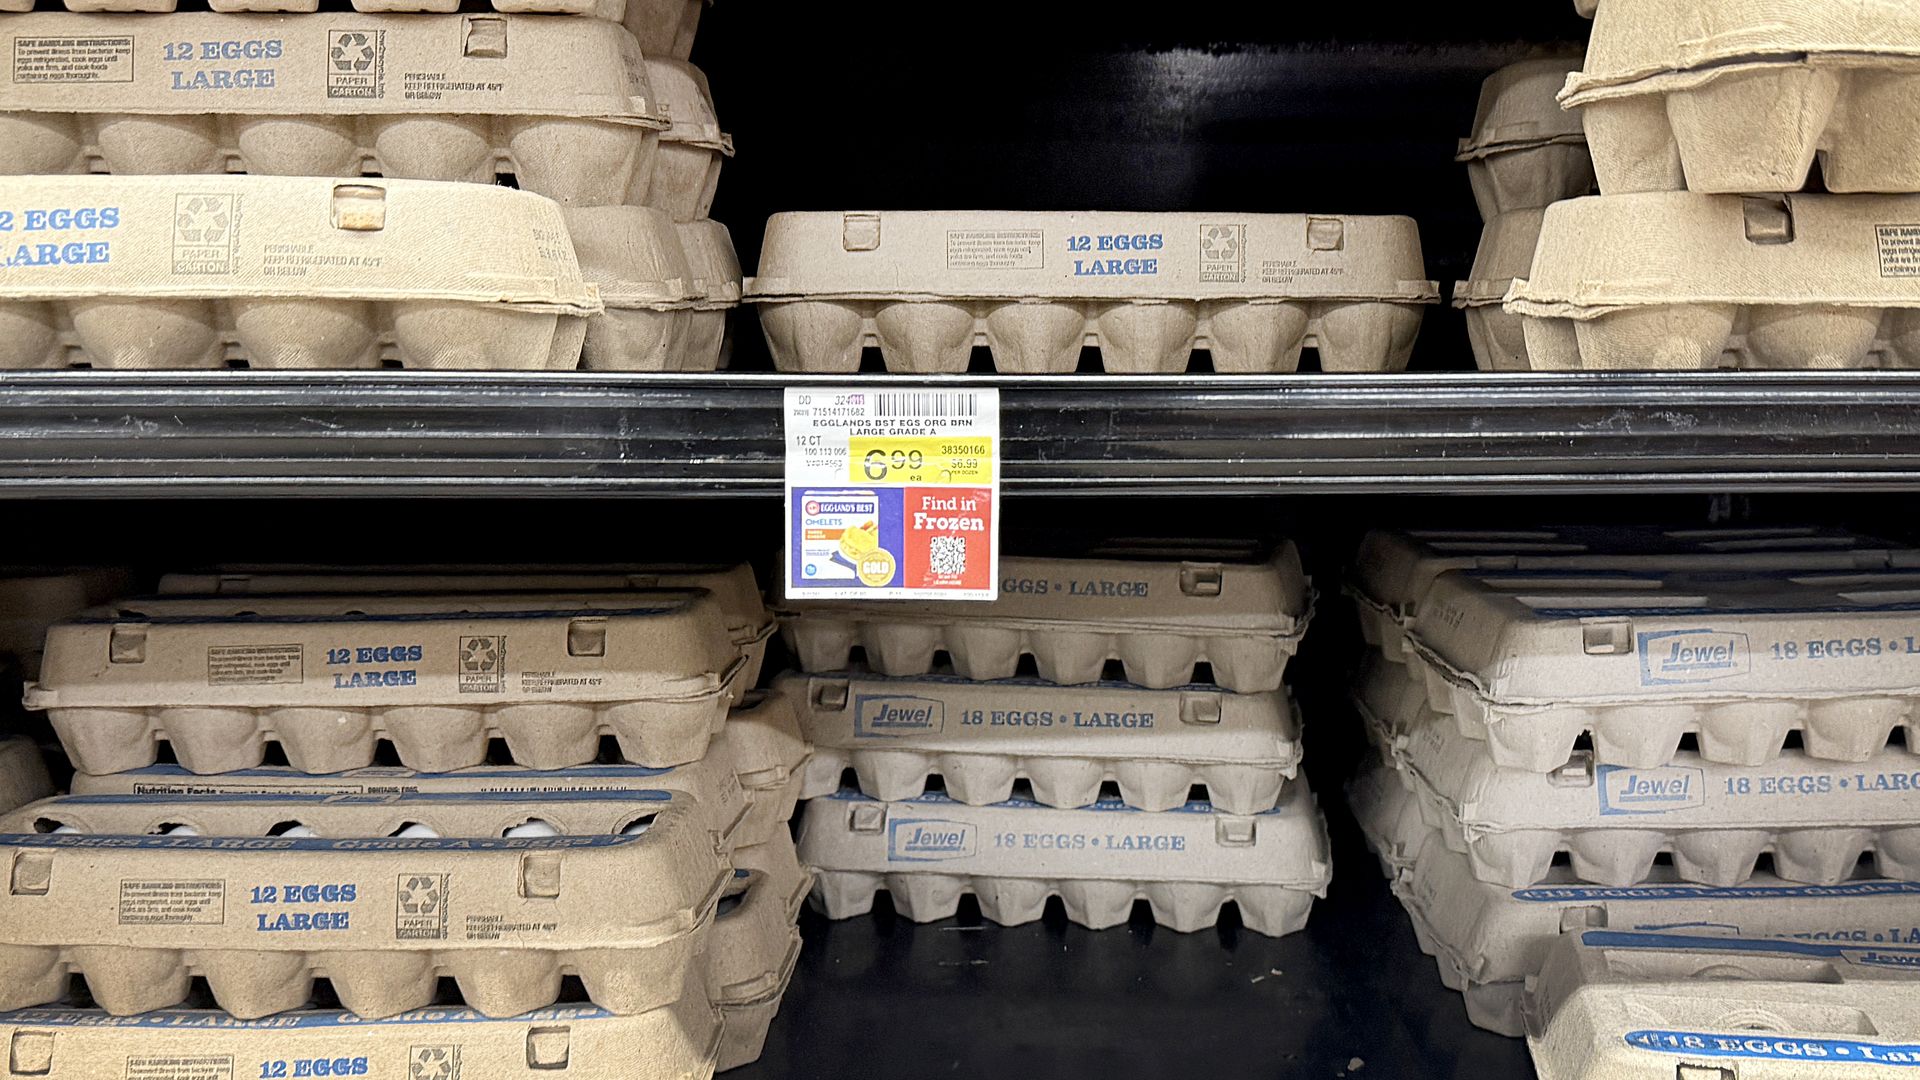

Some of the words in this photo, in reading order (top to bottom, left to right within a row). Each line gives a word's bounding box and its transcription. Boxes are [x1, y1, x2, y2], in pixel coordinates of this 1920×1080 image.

[162, 43, 194, 60] 12
[200, 40, 283, 60] EGGS
[170, 68, 275, 90] LARGE
[336, 77, 368, 85] PAPER
[476, 82, 486, 90] AT
[331, 88, 373, 96] CARTON
[23, 207, 120, 231] EGGS
[1879, 228, 1898, 236] SAFE
[1066, 236, 1092, 252] 12
[1096, 234, 1164, 251] EGGS
[182, 250, 220, 259] PAPER
[1074, 258, 1158, 276] LARGE
[798, 395, 812, 405] DD
[812, 408, 865, 416] 71514171682
[813, 419, 871, 427] EGGLANDS
[796, 436, 806, 446] 12
[809, 436, 822, 446] CT
[942, 445, 985, 454] 38350166
[922, 496, 957, 510] Find
[960, 496, 976, 511] in
[914, 512, 984, 531] Frozen
[862, 562, 890, 574] GOLD
[1001, 578, 1048, 594] GGS
[1069, 580, 1149, 597] LARGE
[326, 648, 350, 665] 12
[356, 645, 422, 664] EGGS
[1662, 640, 1735, 664] Jewel
[1771, 640, 1798, 660] 18
[1806, 637, 1881, 659] EGGS
[333, 670, 416, 689] LARGE
[872, 704, 932, 723] Jewel
[960, 710, 984, 726] 18
[990, 710, 1053, 726] EGGS
[1073, 712, 1154, 728] LARGE
[136, 786, 185, 794] Nutrition
[1620, 774, 1690, 796] Jewel
[1724, 776, 1751, 796] 18
[1758, 775, 1832, 795] EGGS
[165, 838, 296, 850] LARGE
[331, 840, 441, 849] Grade
[448, 840, 473, 849] A
[906, 828, 966, 846] Jewel
[994, 834, 1016, 848] 18
[1022, 834, 1086, 850] EGGS
[1104, 834, 1186, 851] LARGE
[250, 886, 277, 904] 12
[283, 884, 357, 904] EGGS
[1580, 888, 1670, 898] EGGS
[256, 912, 349, 932] LARGE
[404, 920, 433, 928] PAPER
[532, 923, 541, 931] AT
[1717, 1038, 1828, 1057] EGGS
[260, 1061, 287, 1079] 12
[292, 1057, 368, 1078] EGGS
